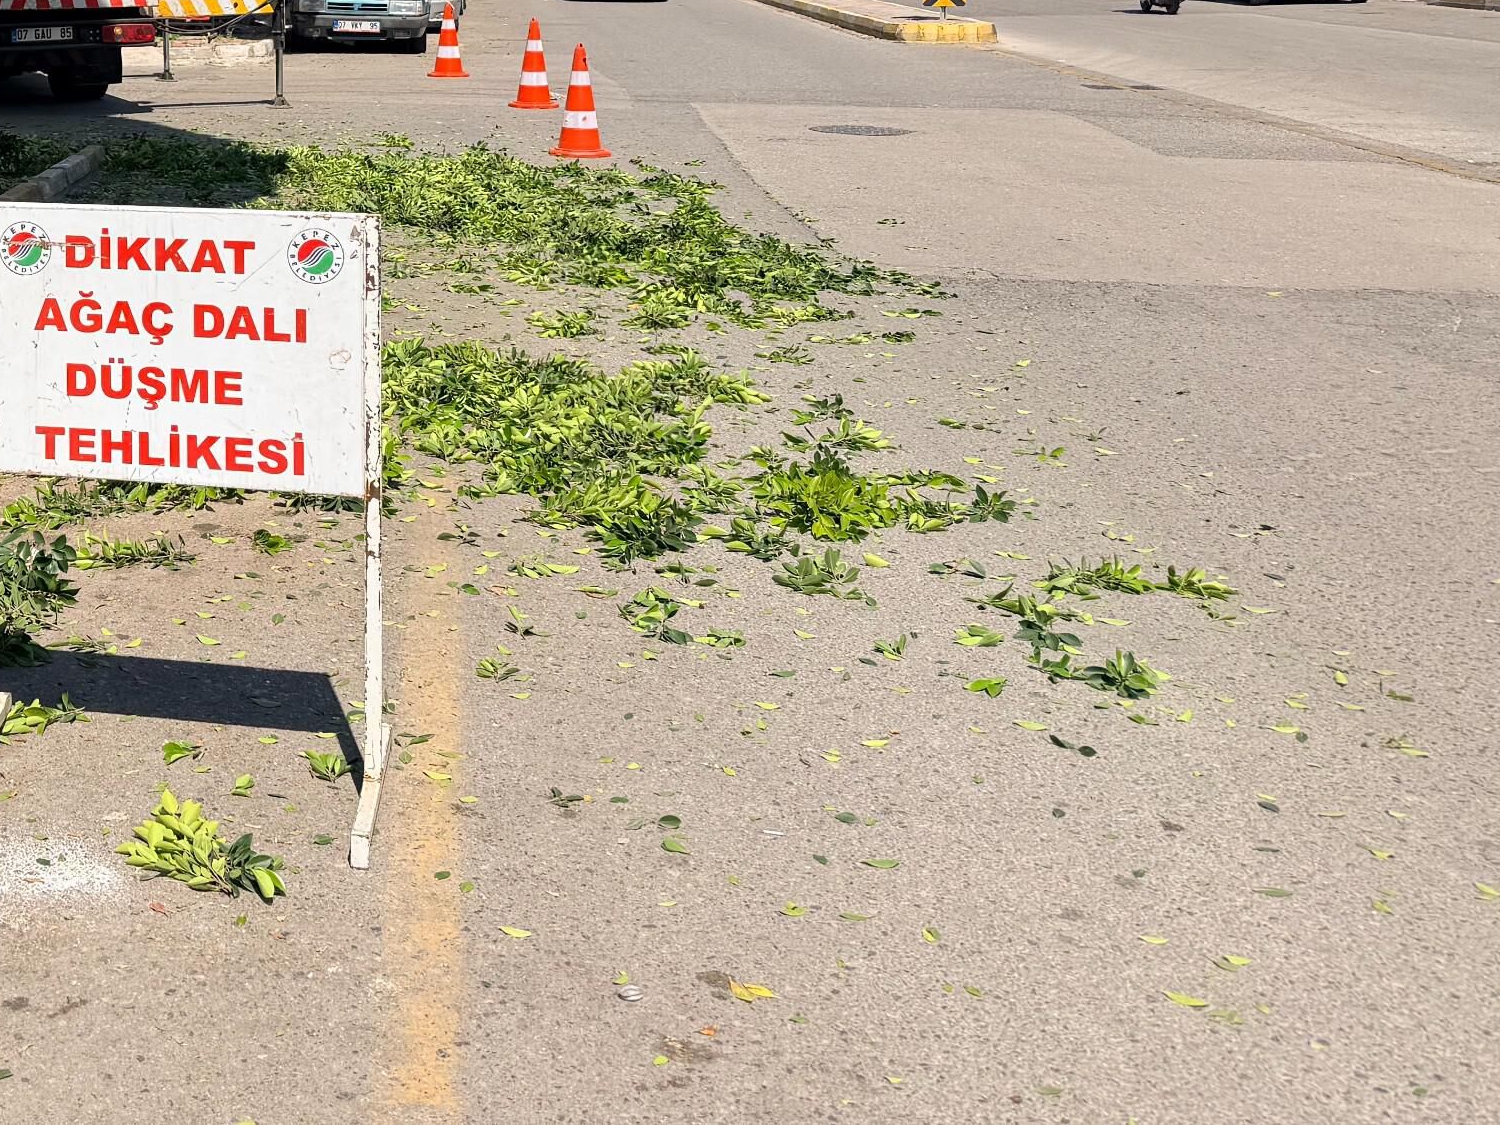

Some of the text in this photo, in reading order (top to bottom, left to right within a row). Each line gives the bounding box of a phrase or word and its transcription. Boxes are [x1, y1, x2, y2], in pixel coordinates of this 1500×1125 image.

[17, 27, 71, 40] 07 GAU 85
[65, 228, 255, 275] DİKKAT
[34, 290, 307, 345] AĞAÇ DALI
[66, 357, 244, 410] DÜŞME
[34, 424, 306, 475] TEHLİKESİ
